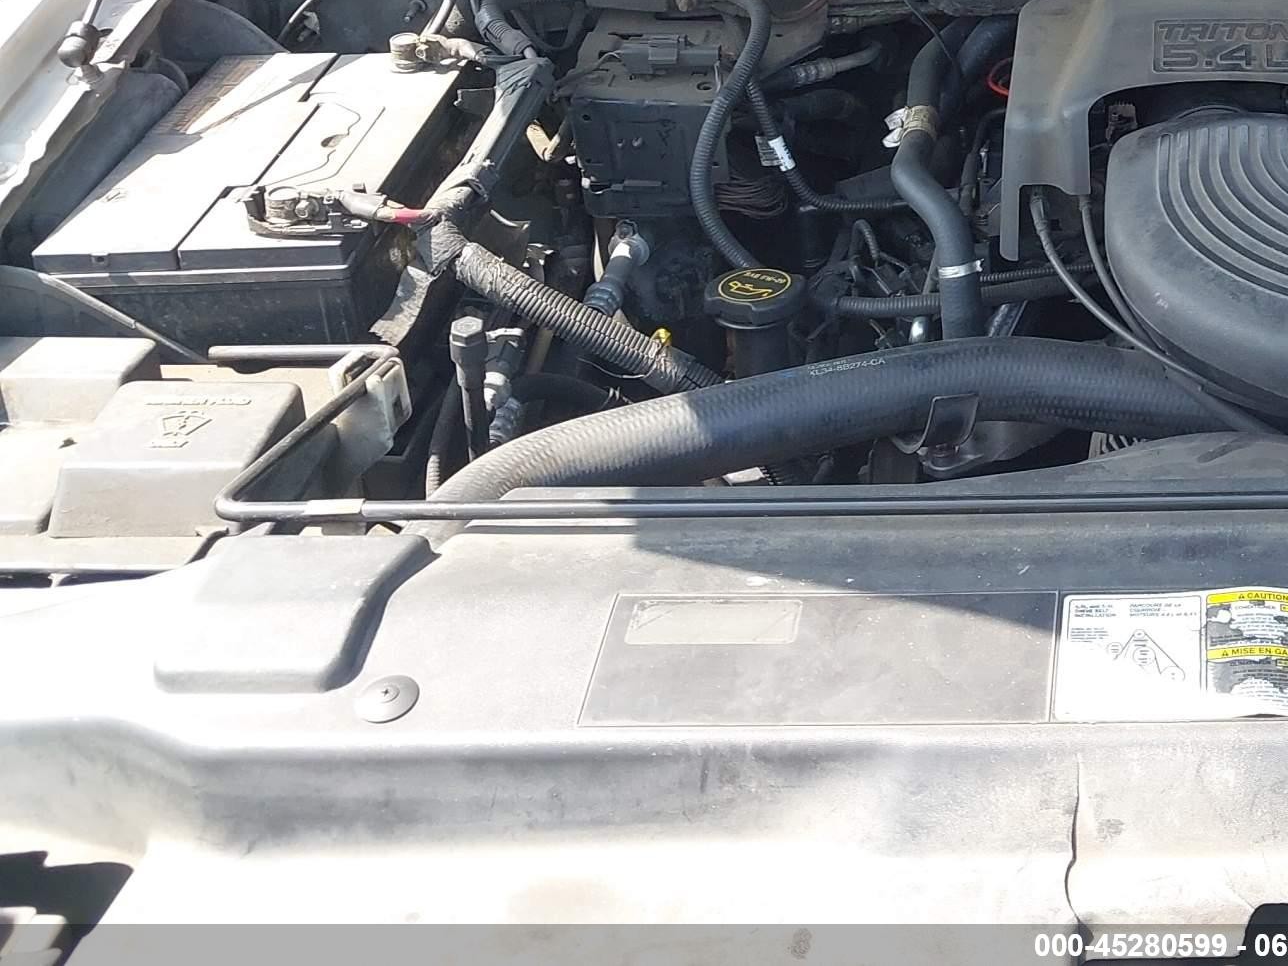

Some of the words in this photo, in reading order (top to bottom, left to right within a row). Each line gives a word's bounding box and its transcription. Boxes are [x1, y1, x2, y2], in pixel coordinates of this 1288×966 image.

[1247, 592, 1288, 601] CAUTION
[1231, 648, 1257, 656] MISE
[1259, 647, 1272, 655] EN
